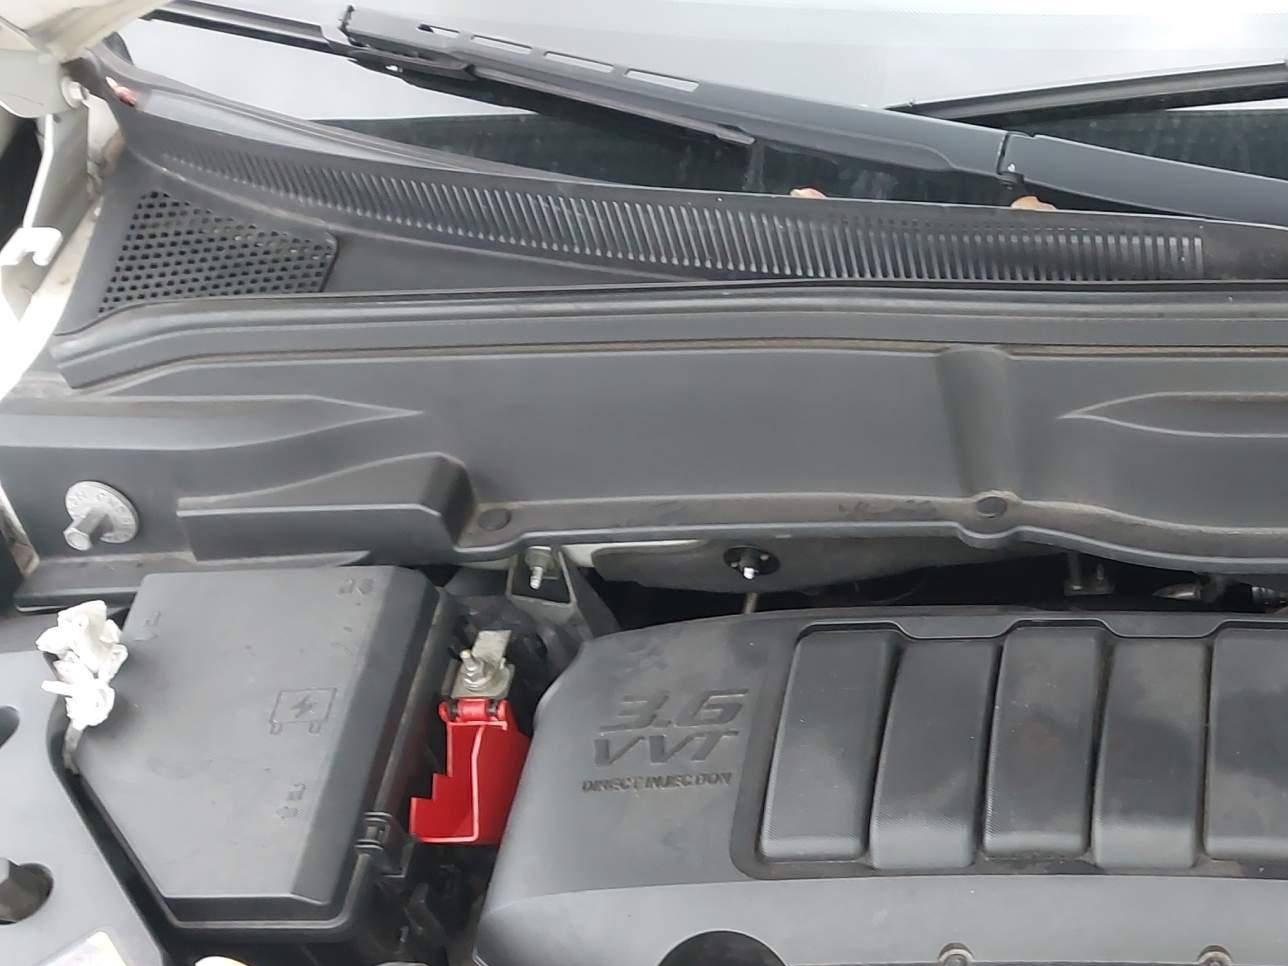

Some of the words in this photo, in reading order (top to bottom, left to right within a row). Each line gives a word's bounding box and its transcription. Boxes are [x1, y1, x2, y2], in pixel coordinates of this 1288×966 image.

[597, 688, 749, 734] 3.6
[594, 729, 740, 766] VVT
[581, 774, 643, 792] DIRECT
[644, 771, 733, 790] INJECTION
